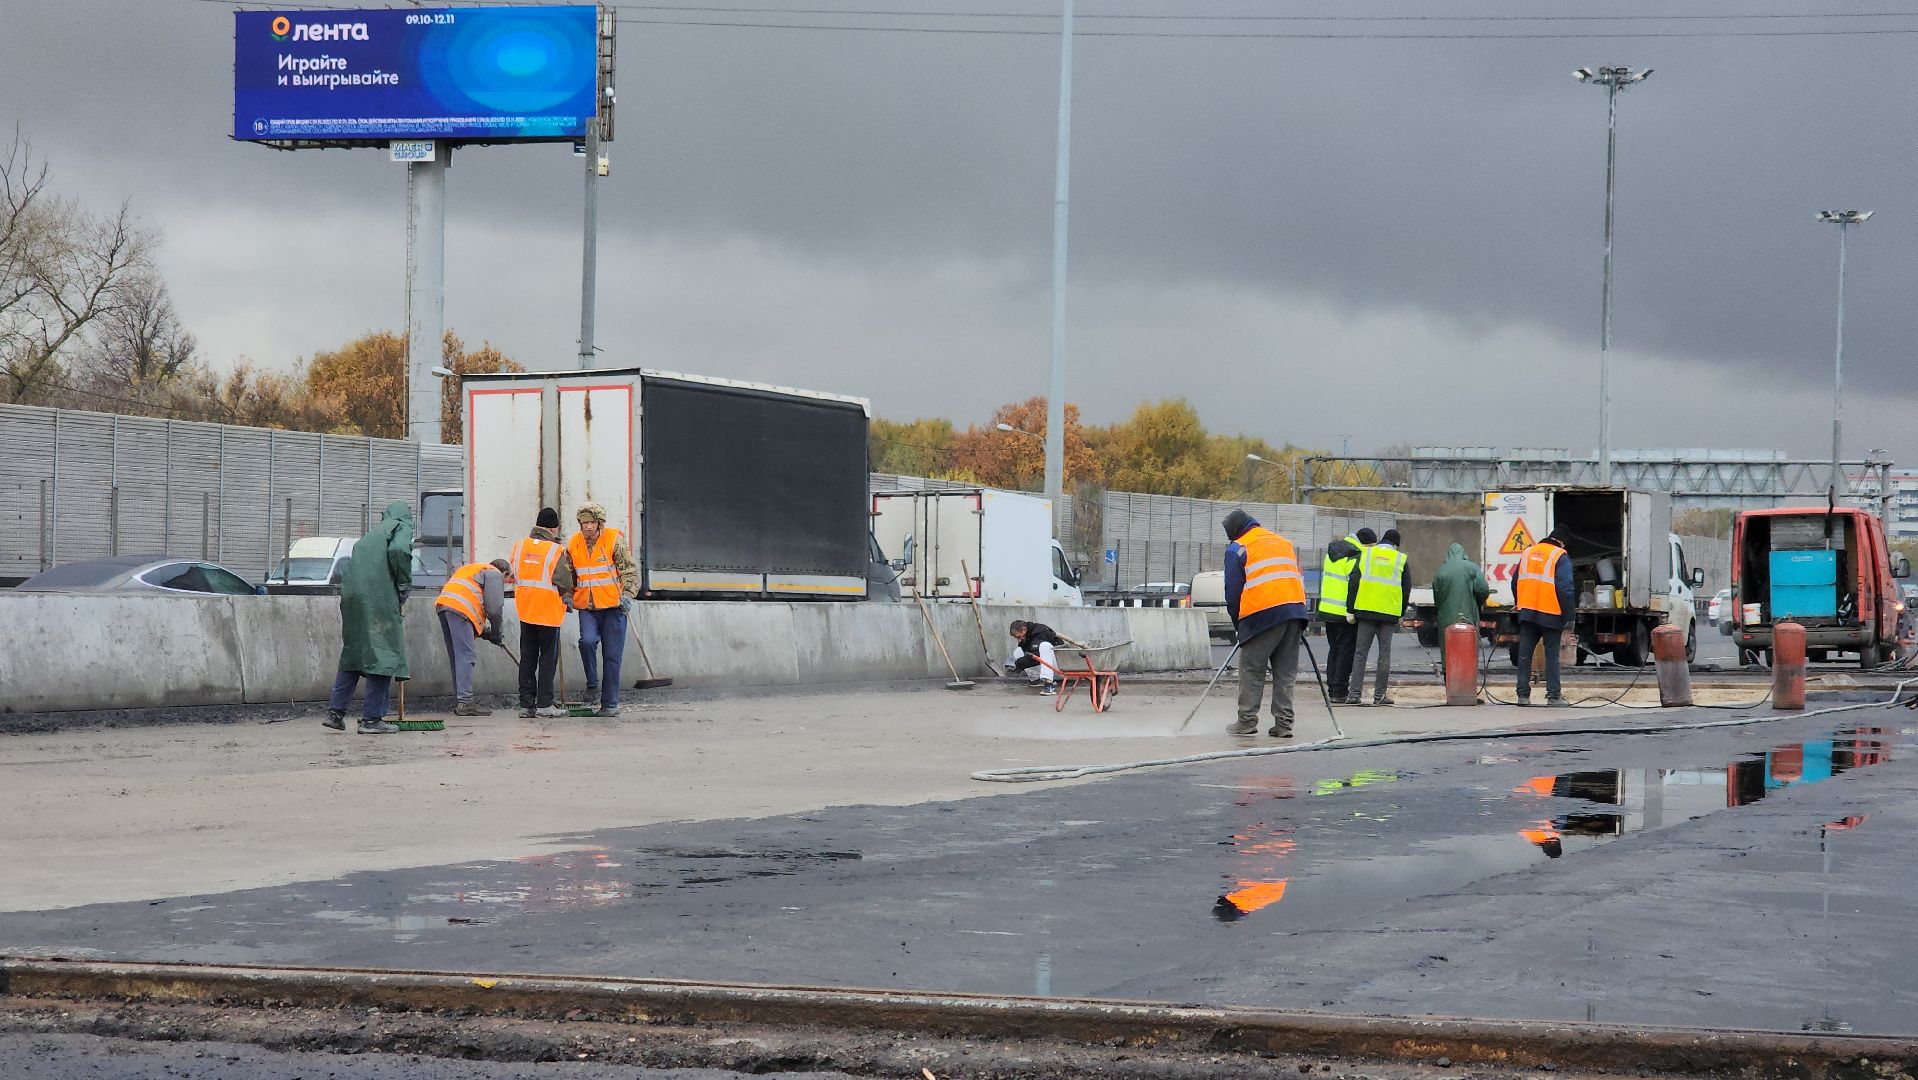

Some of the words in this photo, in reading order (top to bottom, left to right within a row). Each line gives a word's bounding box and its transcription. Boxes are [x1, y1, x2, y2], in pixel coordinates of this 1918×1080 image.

[292, 22, 369, 42] лента
[278, 53, 347, 75] Играйте
[278, 75, 288, 86] и
[293, 70, 399, 90] выигрывайте
